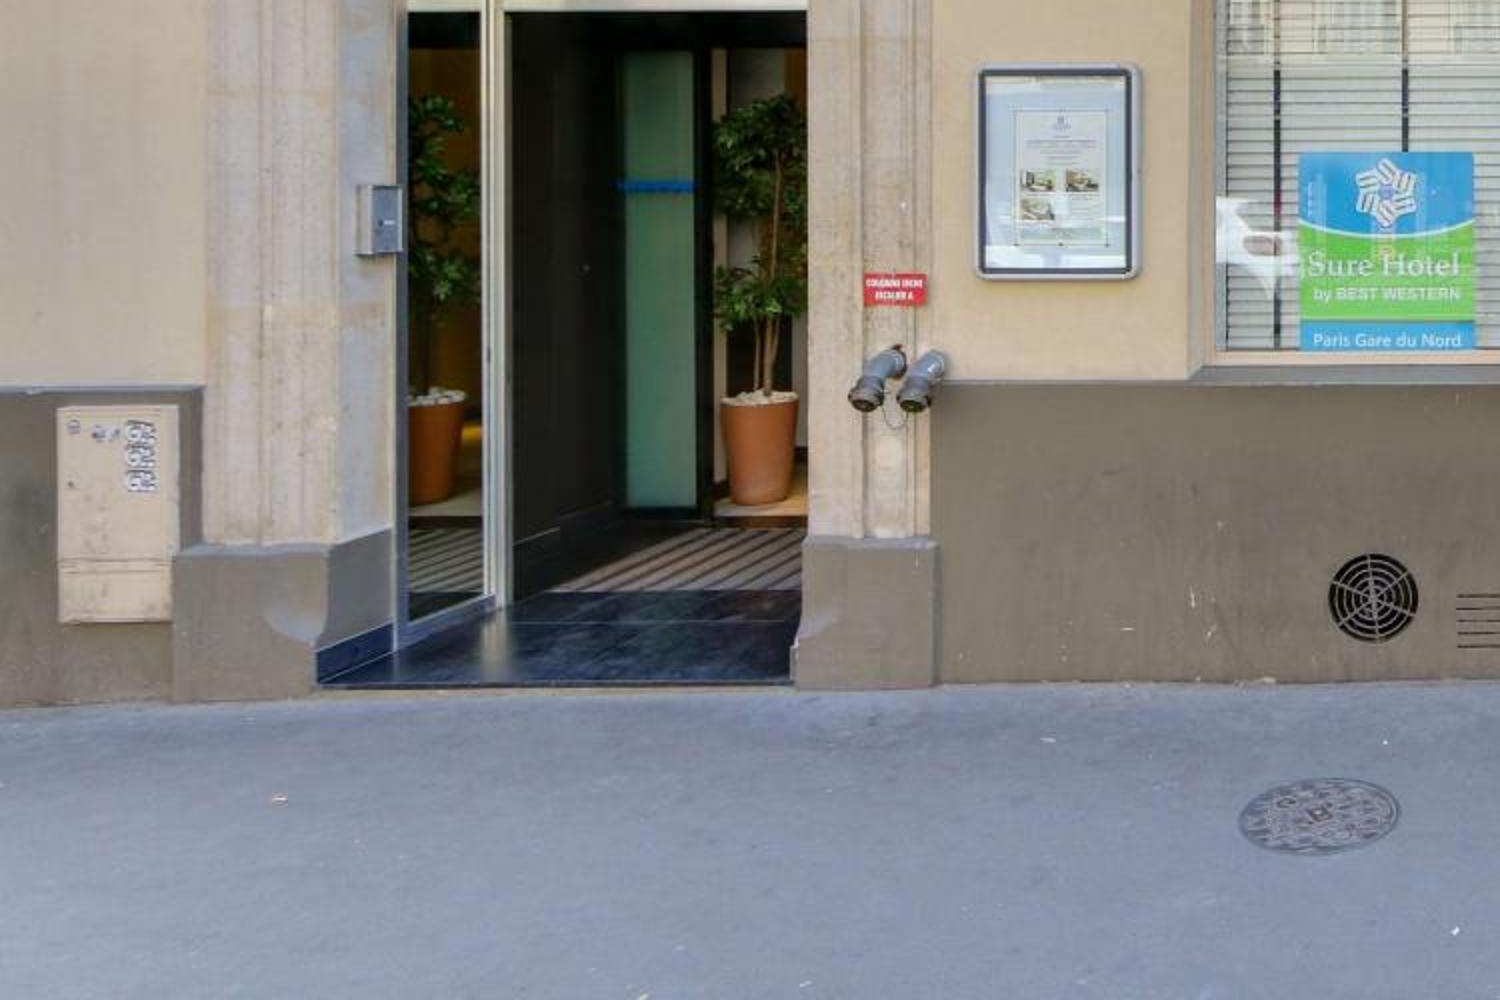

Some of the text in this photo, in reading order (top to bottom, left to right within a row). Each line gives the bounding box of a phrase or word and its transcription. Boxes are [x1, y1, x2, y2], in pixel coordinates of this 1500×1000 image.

[1308, 249, 1460, 277] Sure Hotel
[1313, 287, 1462, 303] by BEST WESTERN
[1312, 332, 1462, 348] Paris Gare du Nord
